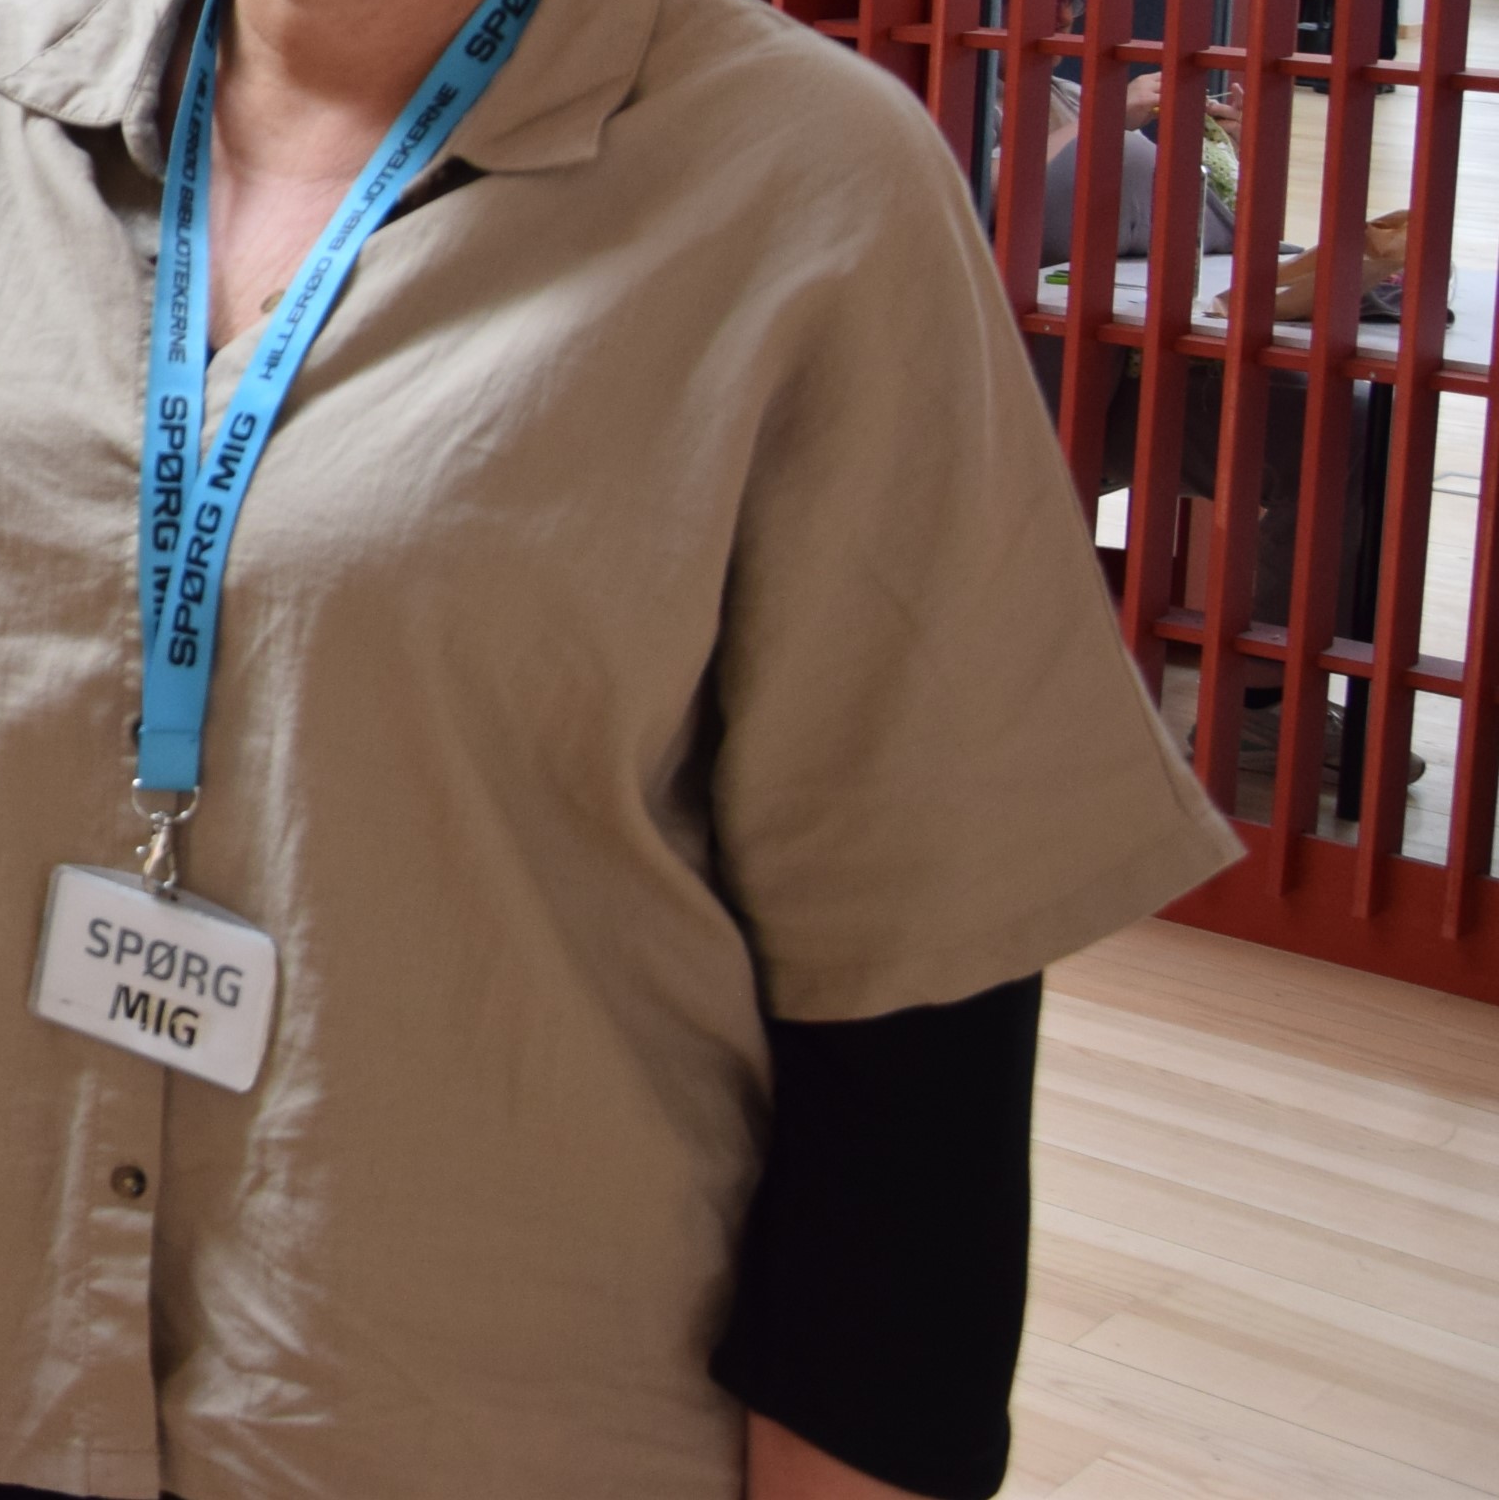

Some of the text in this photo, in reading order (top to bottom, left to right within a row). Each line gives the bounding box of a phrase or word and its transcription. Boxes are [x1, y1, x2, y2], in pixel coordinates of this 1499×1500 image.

[181, 67, 210, 182] HILLERØD
[168, 182, 197, 364] BIBLIOTEKERNE
[168, 502, 222, 668] SPØRG
[208, 411, 257, 492] MIG
[260, 252, 333, 381] HILLERØD
[328, 82, 461, 252] BIBLIOTEKERNE
[152, 396, 188, 553] SPØRG
[85, 917, 244, 1008] SPØRG
[108, 983, 199, 1049] MIG
